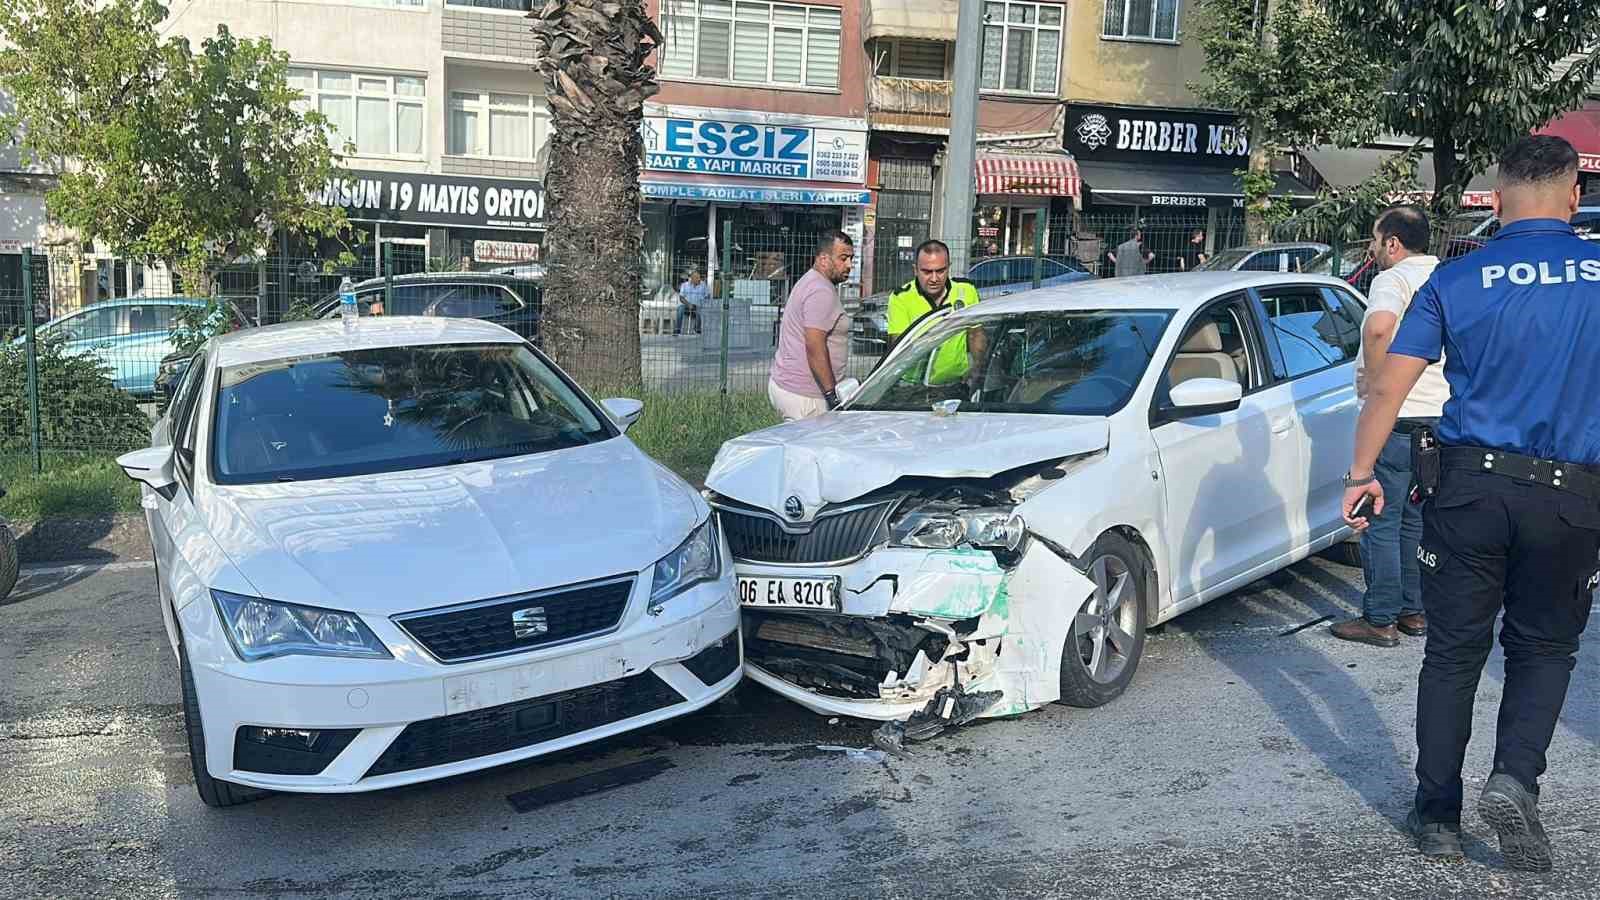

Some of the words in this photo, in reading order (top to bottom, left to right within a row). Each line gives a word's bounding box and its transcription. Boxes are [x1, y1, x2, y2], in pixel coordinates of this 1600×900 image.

[1116, 119, 1198, 154] BERBER
[1206, 124, 1250, 156] MUS
[688, 158, 697, 169] &
[702, 159, 736, 173] YAPI
[740, 161, 802, 176] MARKET
[390, 182, 413, 211] 19
[1151, 195, 1207, 206] BERBER
[740, 580, 757, 603] 06
[767, 580, 786, 604] EA
